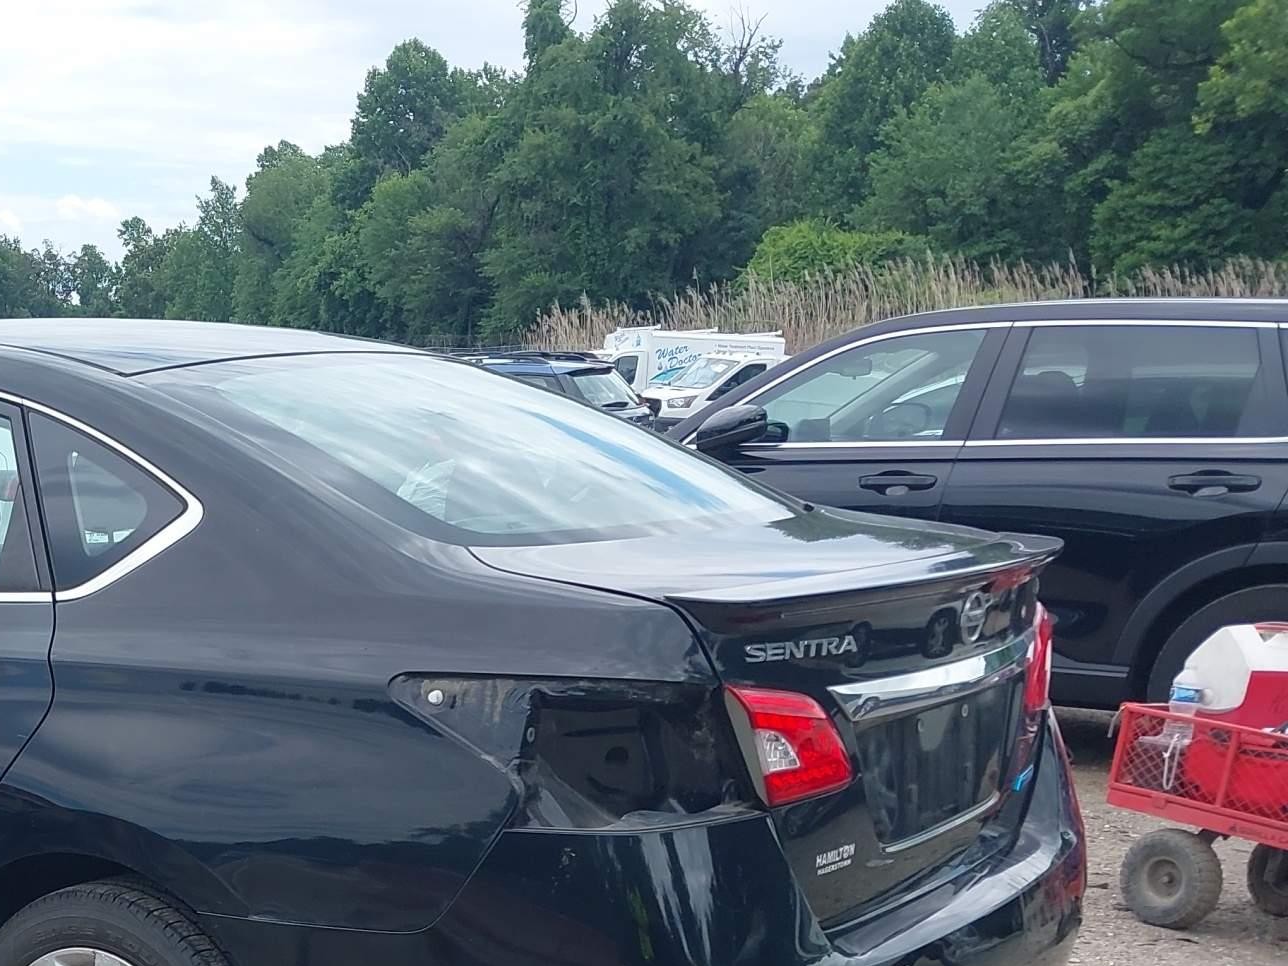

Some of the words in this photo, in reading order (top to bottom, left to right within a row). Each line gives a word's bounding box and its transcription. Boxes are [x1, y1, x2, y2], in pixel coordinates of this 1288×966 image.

[655, 345, 689, 361] Water
[744, 635, 858, 663] SENTRA
[815, 843, 856, 868] HAMILTON
